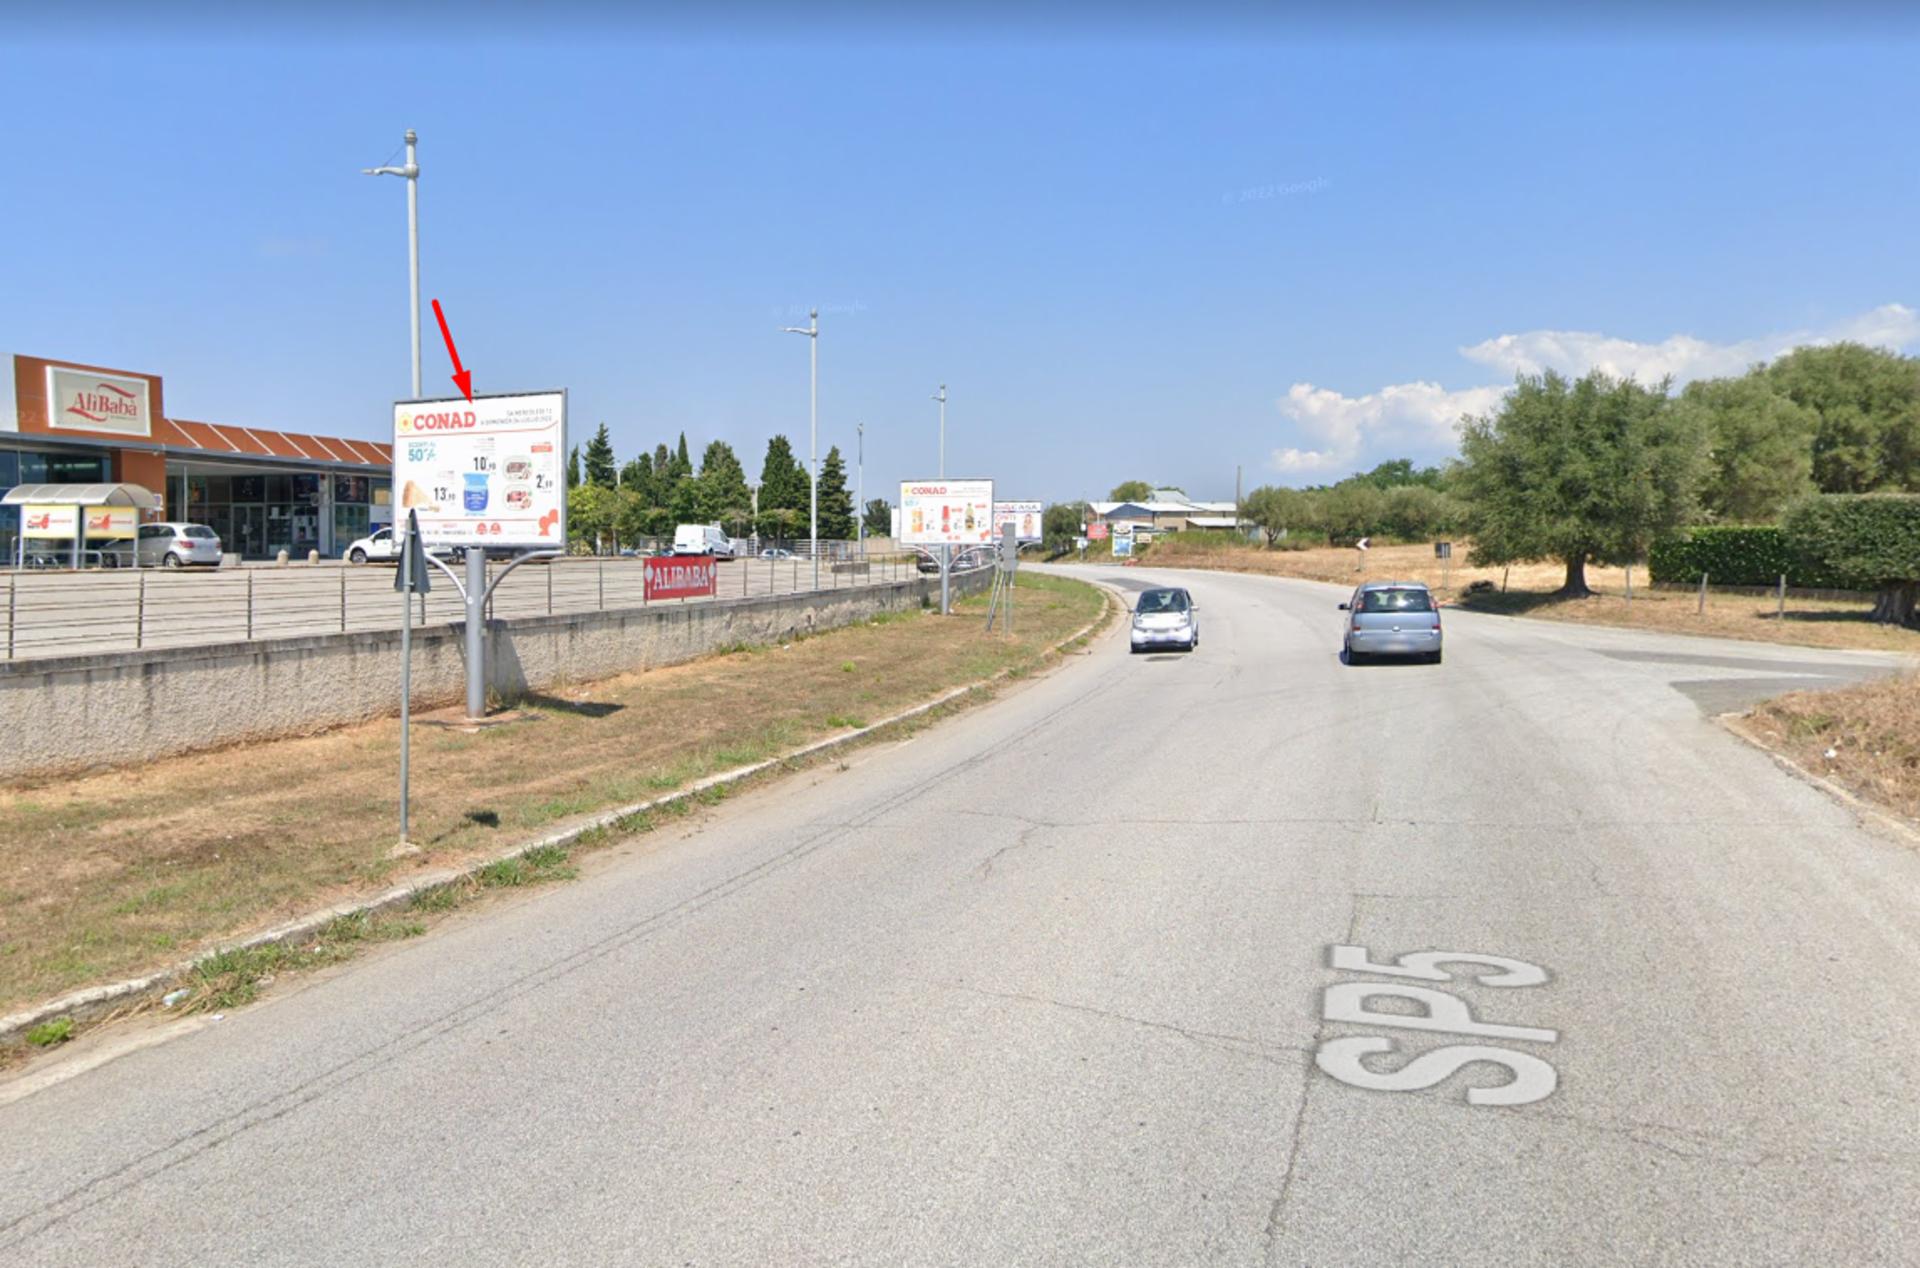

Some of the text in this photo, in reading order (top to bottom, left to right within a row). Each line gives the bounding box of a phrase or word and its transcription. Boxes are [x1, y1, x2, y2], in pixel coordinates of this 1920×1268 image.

[413, 411, 476, 431] CONAD
[911, 487, 947, 495] CONAD
[653, 565, 708, 590] ALIBABA
